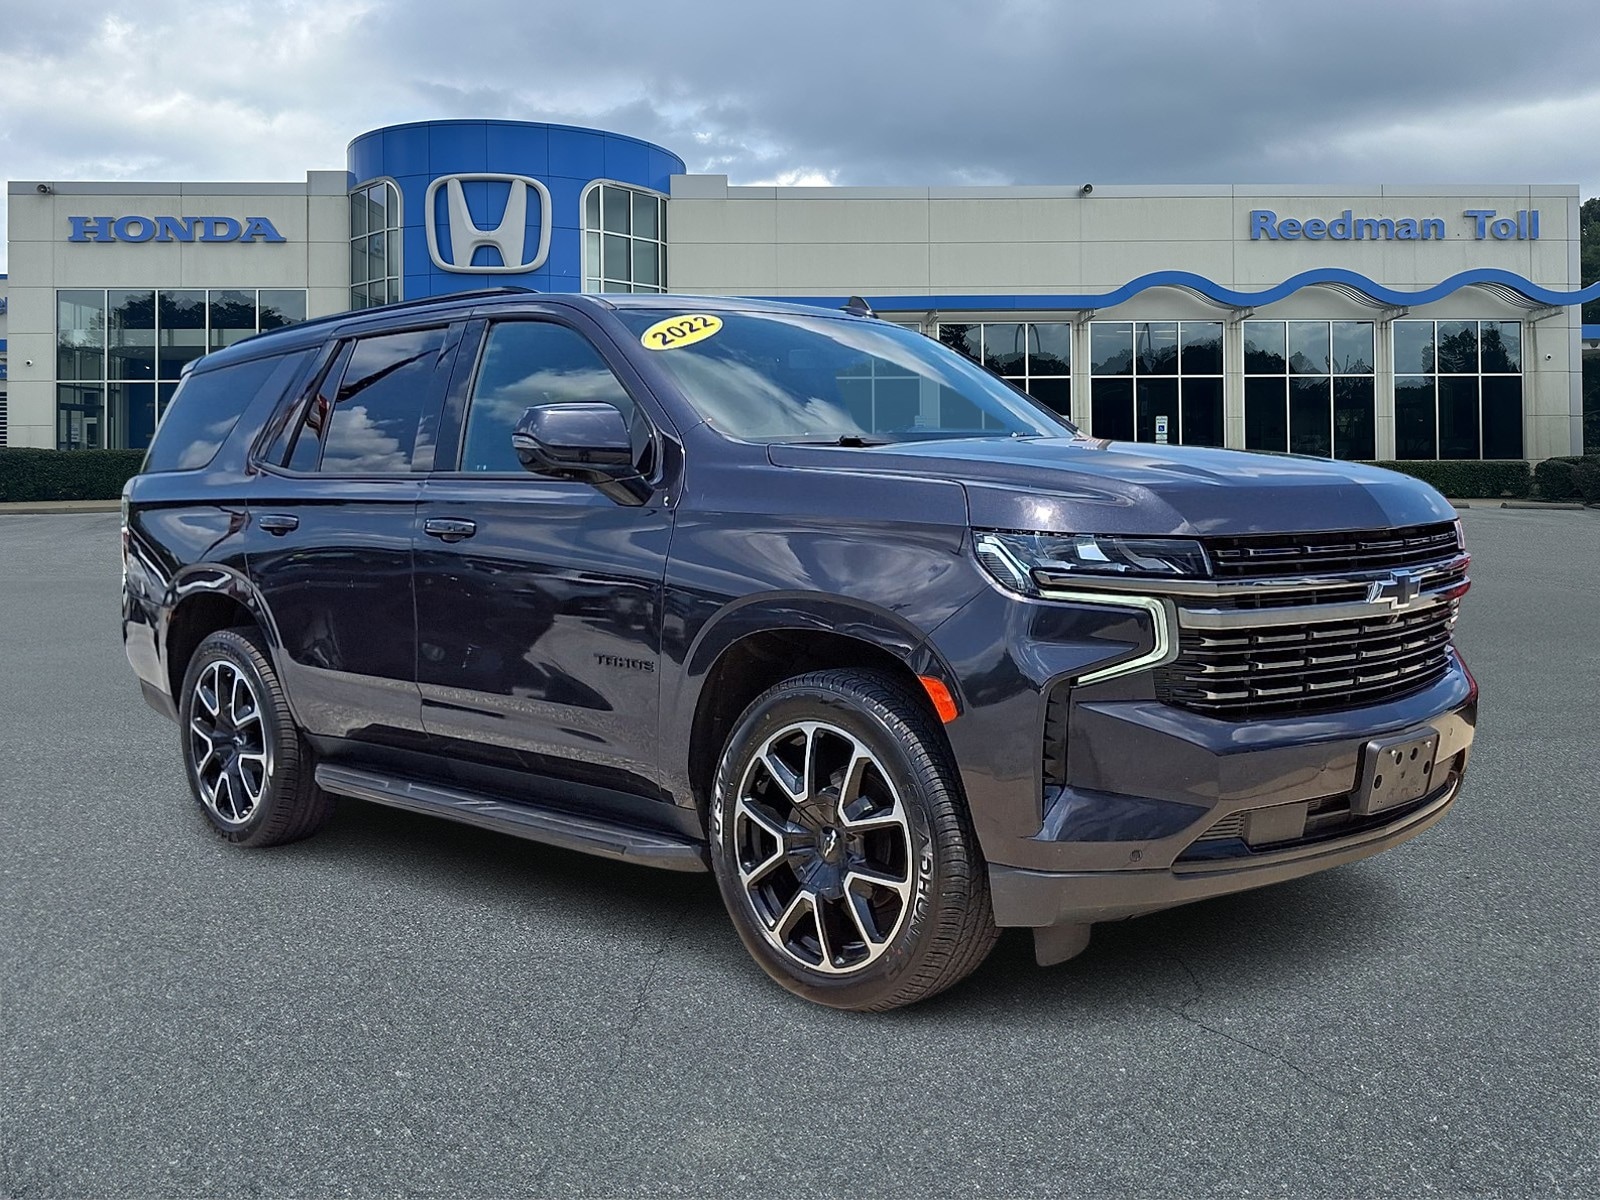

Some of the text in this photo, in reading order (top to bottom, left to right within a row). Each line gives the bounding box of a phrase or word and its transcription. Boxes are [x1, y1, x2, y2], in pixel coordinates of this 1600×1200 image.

[68, 215, 287, 243] HONDA
[1250, 209, 1539, 241] Reedman Toll
[652, 316, 715, 346] 2022
